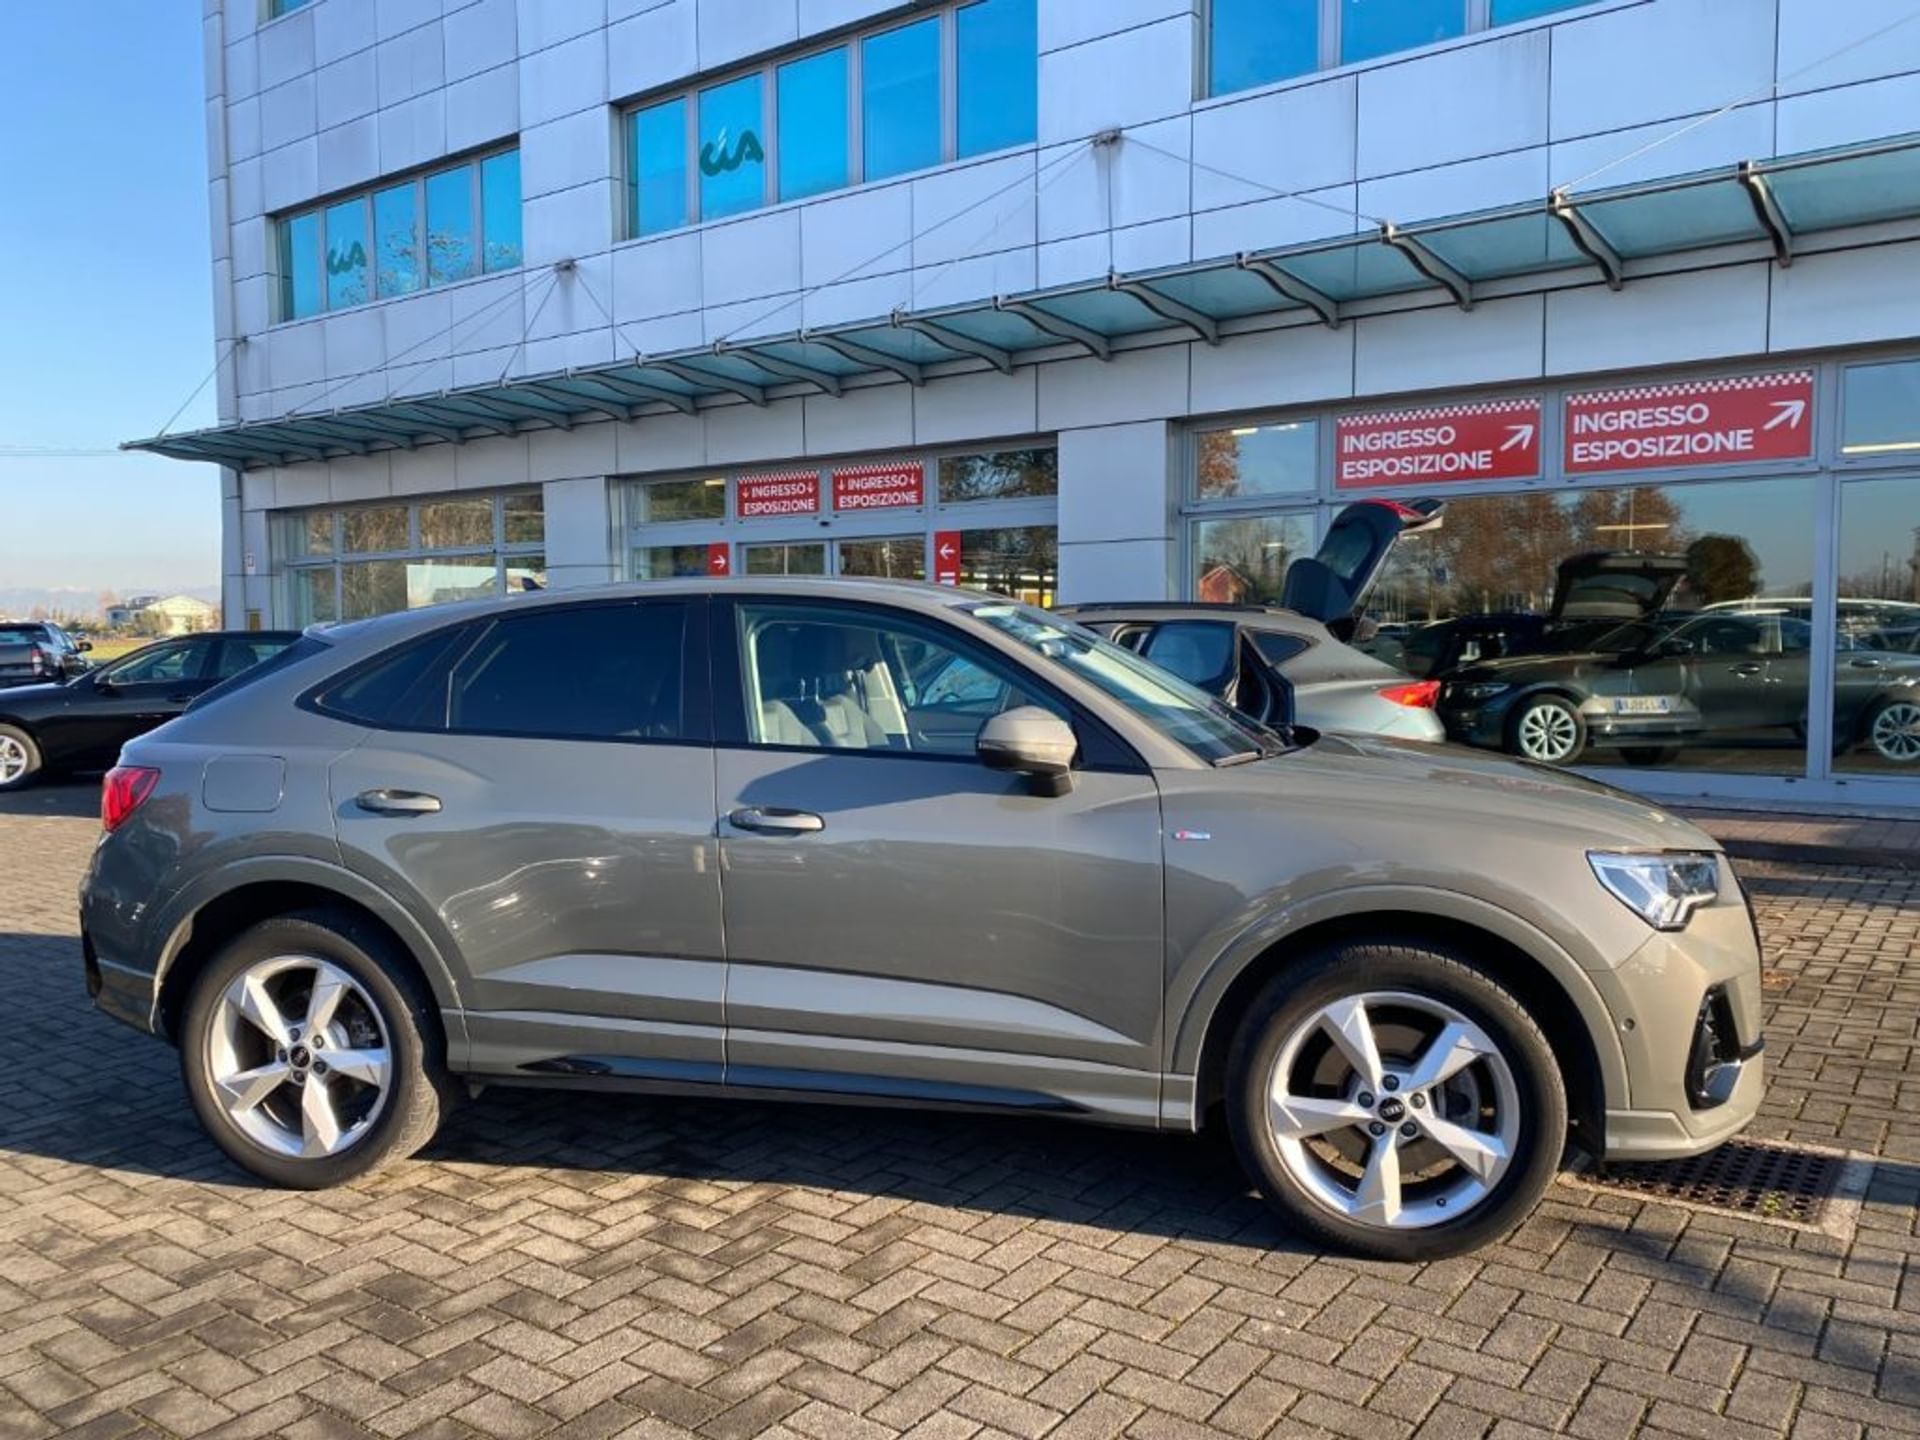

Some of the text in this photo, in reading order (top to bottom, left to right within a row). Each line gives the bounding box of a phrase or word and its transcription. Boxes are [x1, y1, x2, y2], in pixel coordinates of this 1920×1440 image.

[1573, 403, 1710, 434] INGRESSO
[1343, 426, 1456, 453] INGRESSO
[1573, 429, 1754, 463] ESPOSIZIONE
[1342, 451, 1493, 478] ESPOSIZIONE
[751, 483, 806, 498] INGRESSO
[846, 474, 908, 491] INGRESSO
[743, 499, 815, 515] ESPOSIZIONE
[839, 491, 919, 508] ESPOSIZIONE
